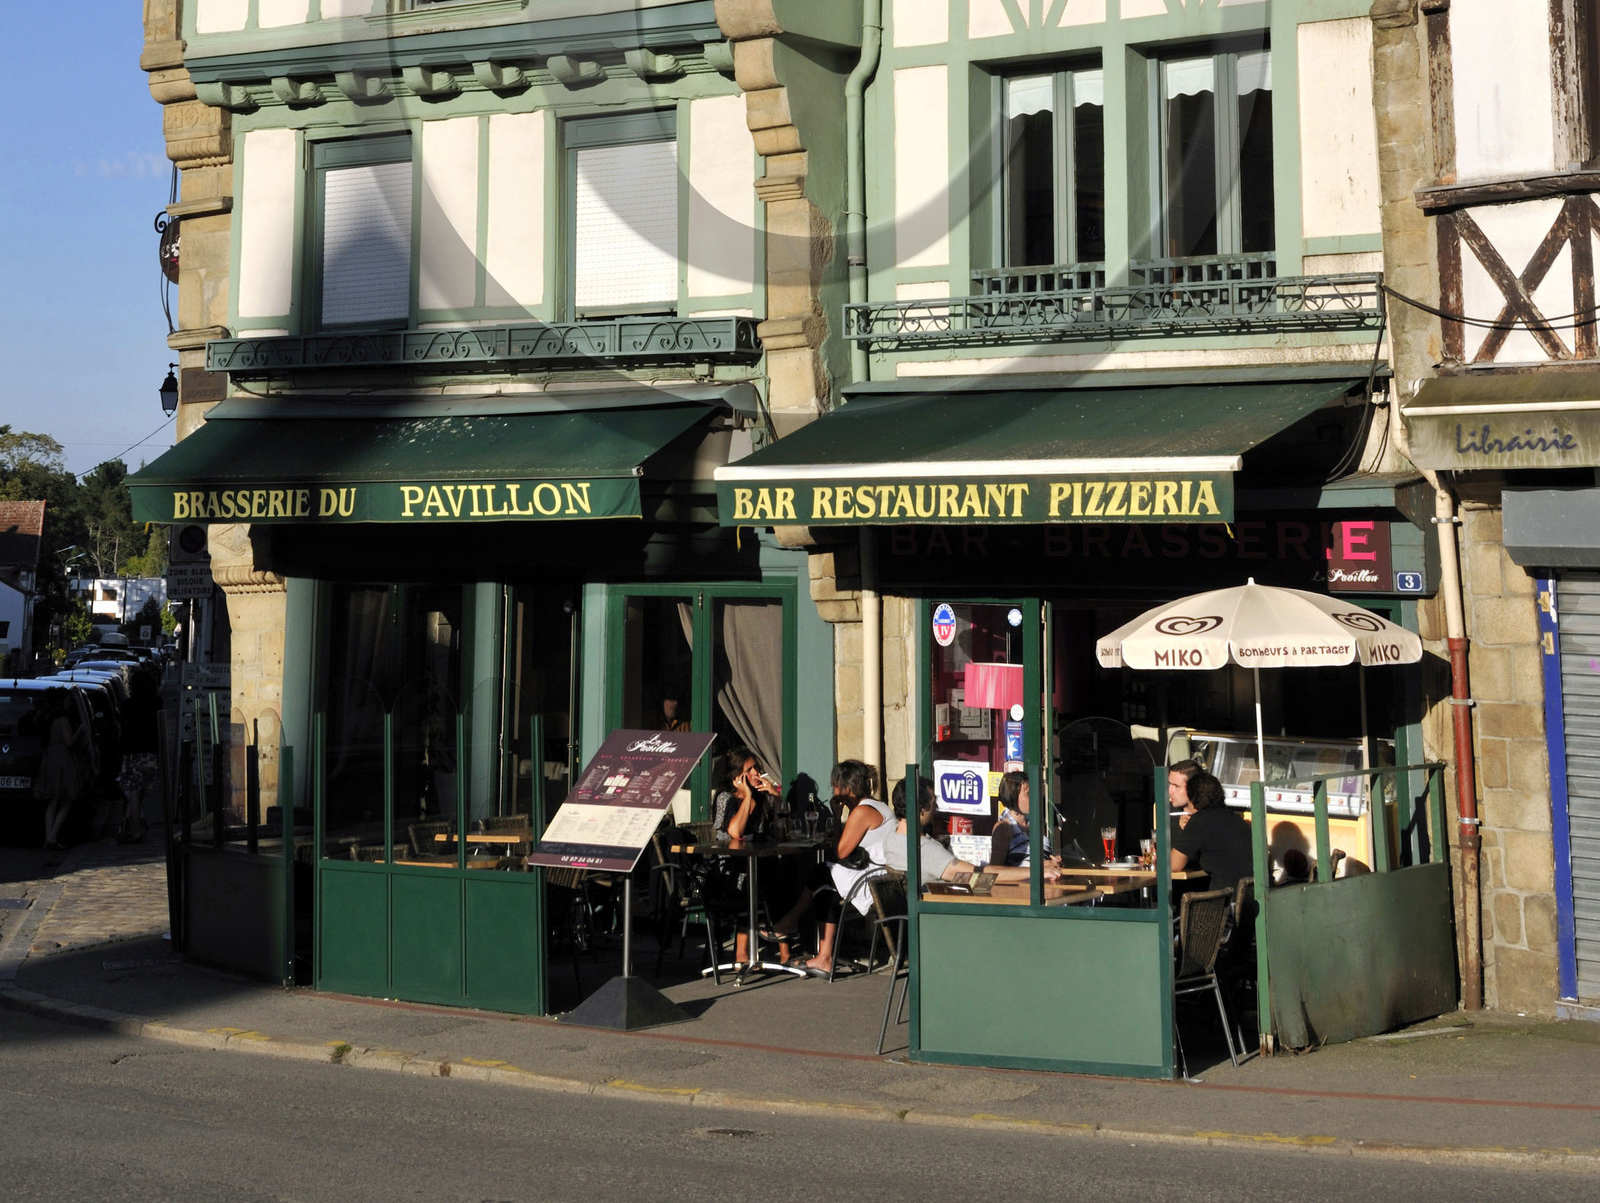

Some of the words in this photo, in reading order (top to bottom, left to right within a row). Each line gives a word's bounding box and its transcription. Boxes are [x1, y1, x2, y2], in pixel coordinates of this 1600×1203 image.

[1456, 423, 1577, 454] Librairie
[173, 488, 311, 519] BRASSERIE
[318, 487, 357, 517] DU
[400, 482, 591, 518] PAVILLON
[734, 487, 797, 519] BAR
[811, 483, 1030, 519] RESTAURANT
[1048, 480, 1221, 517] PIZZERIA
[1043, 520, 1376, 561] BRASSERE
[168, 568, 188, 577] ZONE
[176, 577, 203, 586] DISQUE
[1328, 568, 1380, 583] Pavillon
[1404, 574, 1415, 589] 3
[168, 587, 212, 596] OBLIGATOIRE
[1154, 648, 1203, 666] MIKO
[1368, 644, 1400, 663] MIKO
[626, 739, 678, 754] Pavillon
[943, 778, 979, 801] WiFi
